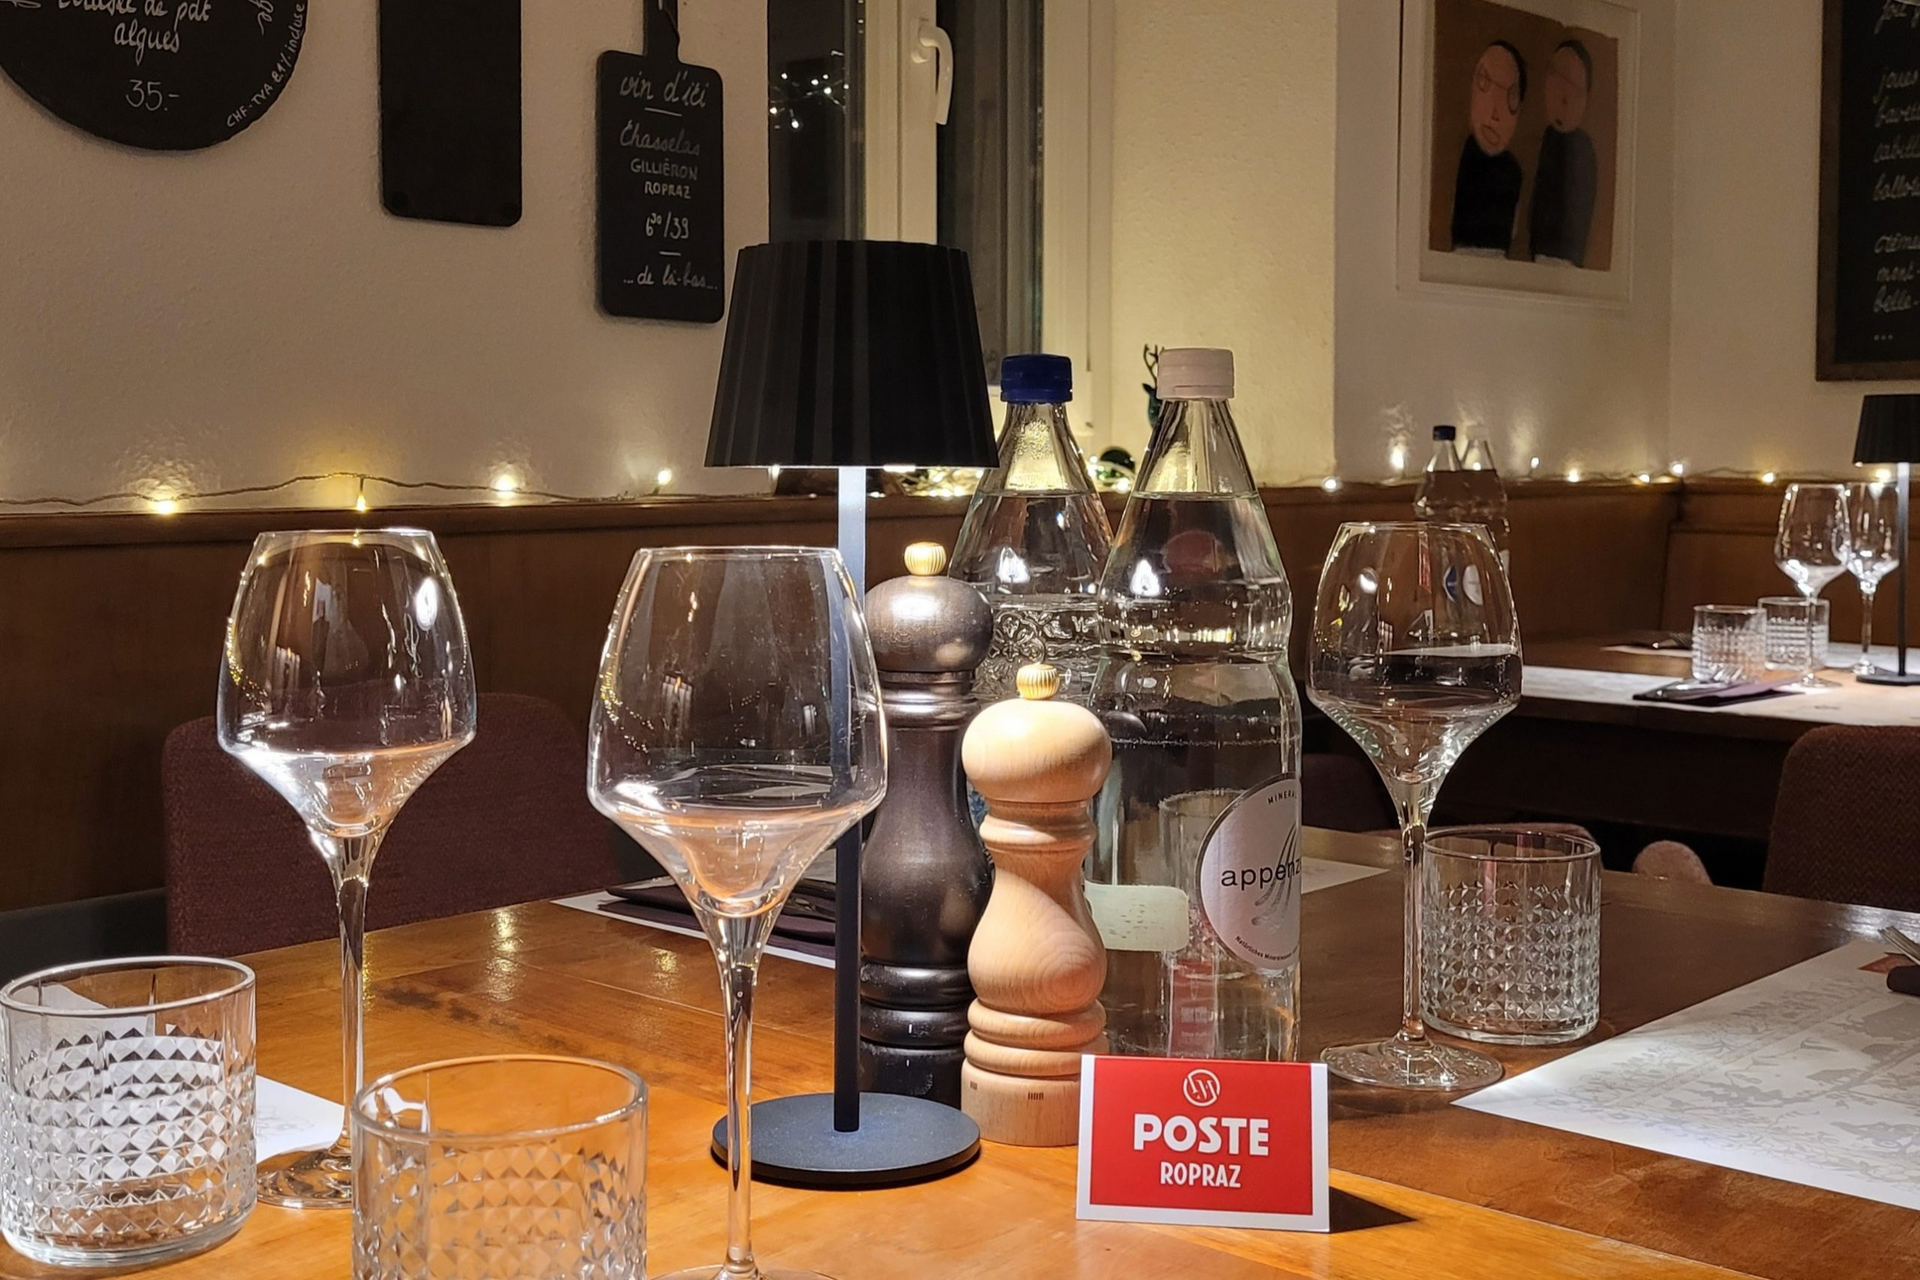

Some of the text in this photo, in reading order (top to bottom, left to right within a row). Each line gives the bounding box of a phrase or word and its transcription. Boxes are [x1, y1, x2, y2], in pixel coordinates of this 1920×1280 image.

[114, 19, 180, 65] algues
[284, 3, 305, 53] incluse
[620, 70, 709, 107] vin d'ici
[620, 120, 701, 156] Chasselas
[630, 158, 699, 181] GILLIÉRON
[644, 180, 692, 199] ROPRAZ
[1133, 1113, 1269, 1156] POSTE
[1160, 1161, 1242, 1188] ROPRAZ
